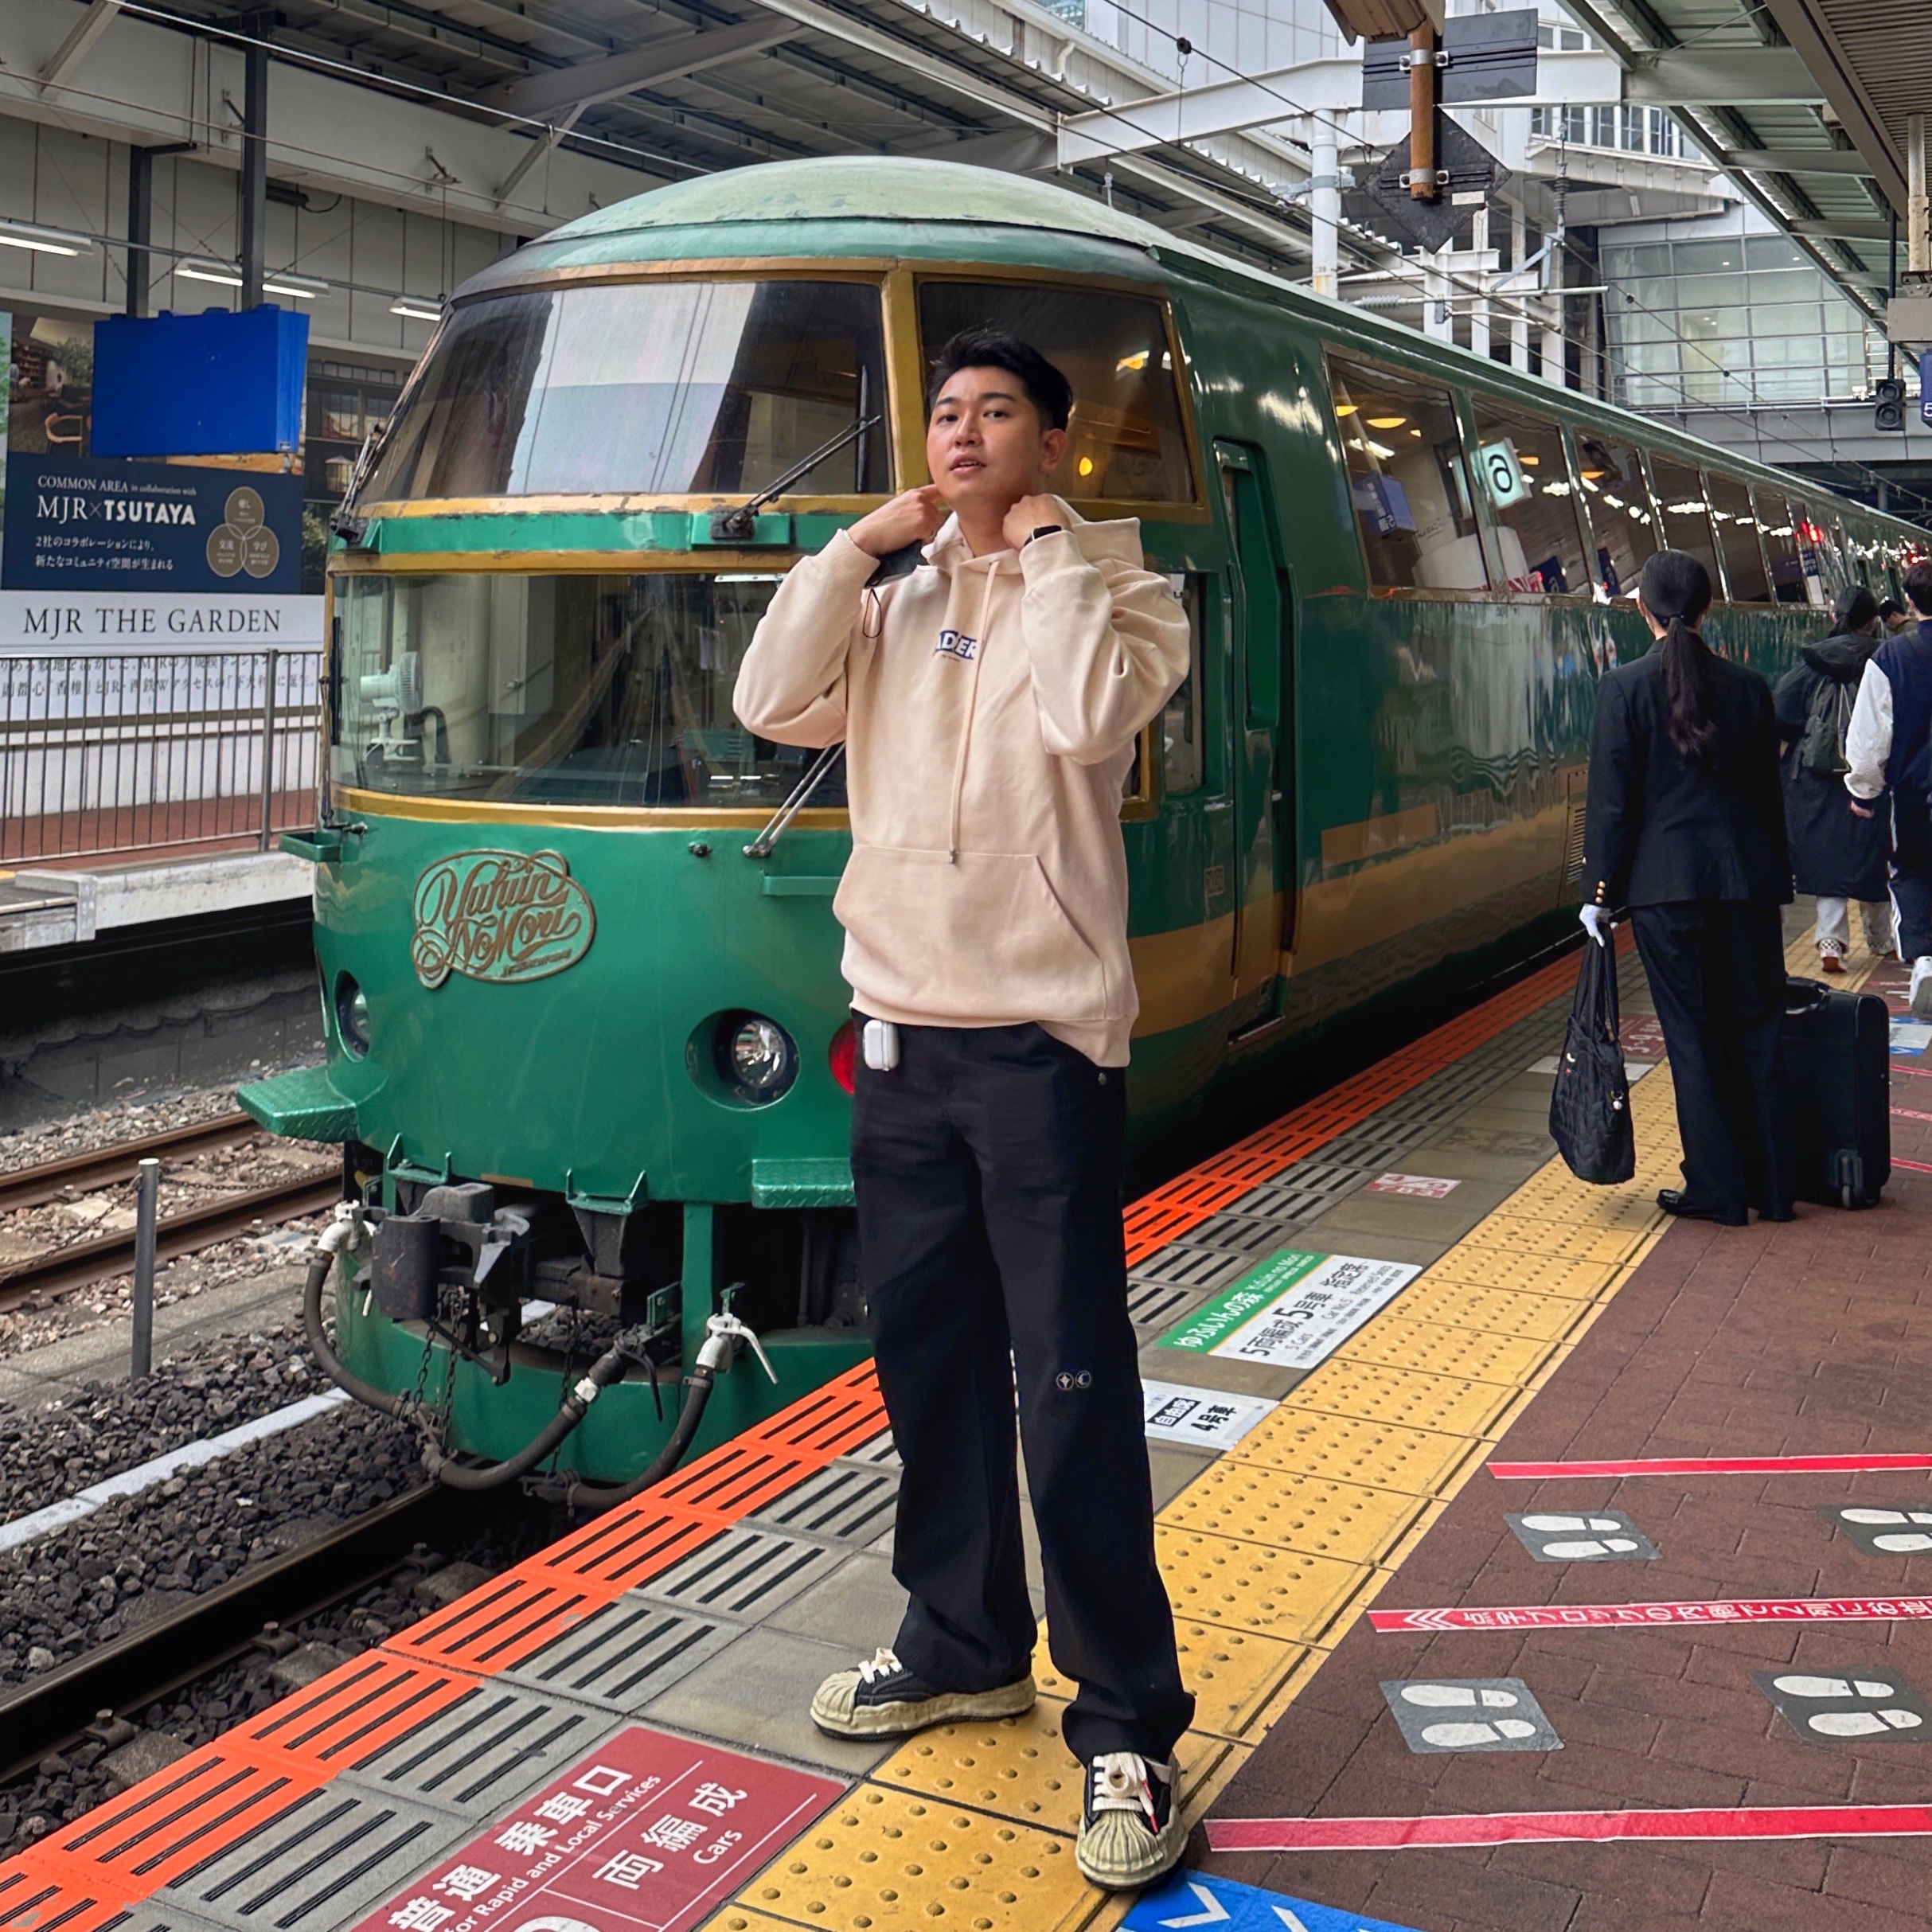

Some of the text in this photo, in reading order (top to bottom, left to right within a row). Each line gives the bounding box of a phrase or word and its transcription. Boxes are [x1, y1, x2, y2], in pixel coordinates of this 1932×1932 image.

[37, 475, 96, 490] COMMON
[99, 481, 128, 493] AREA
[139, 484, 181, 495] collaboration
[182, 487, 197, 496] with
[24, 608, 281, 640] MJR THE GARDEN
[1173, 1292, 1264, 1348] ゆふいんの森
[1239, 1317, 1304, 1356] 5両編成
[1272, 1291, 1333, 1321] 5号車
[1319, 1262, 1369, 1290] 指定席
[1154, 1399, 1196, 1427] 自由席
[1190, 1404, 1237, 1432] 4号車
[1462, 1598, 1932, 1627] 点字ブロックの内側で2列にお並
[494, 1764, 634, 1856] 乗車口
[472, 1876, 529, 1919] Rapid
[529, 1852, 561, 1879] and
[555, 1819, 603, 1856] Local
[595, 1774, 662, 1822] Services
[693, 1829, 743, 1865] Cars
